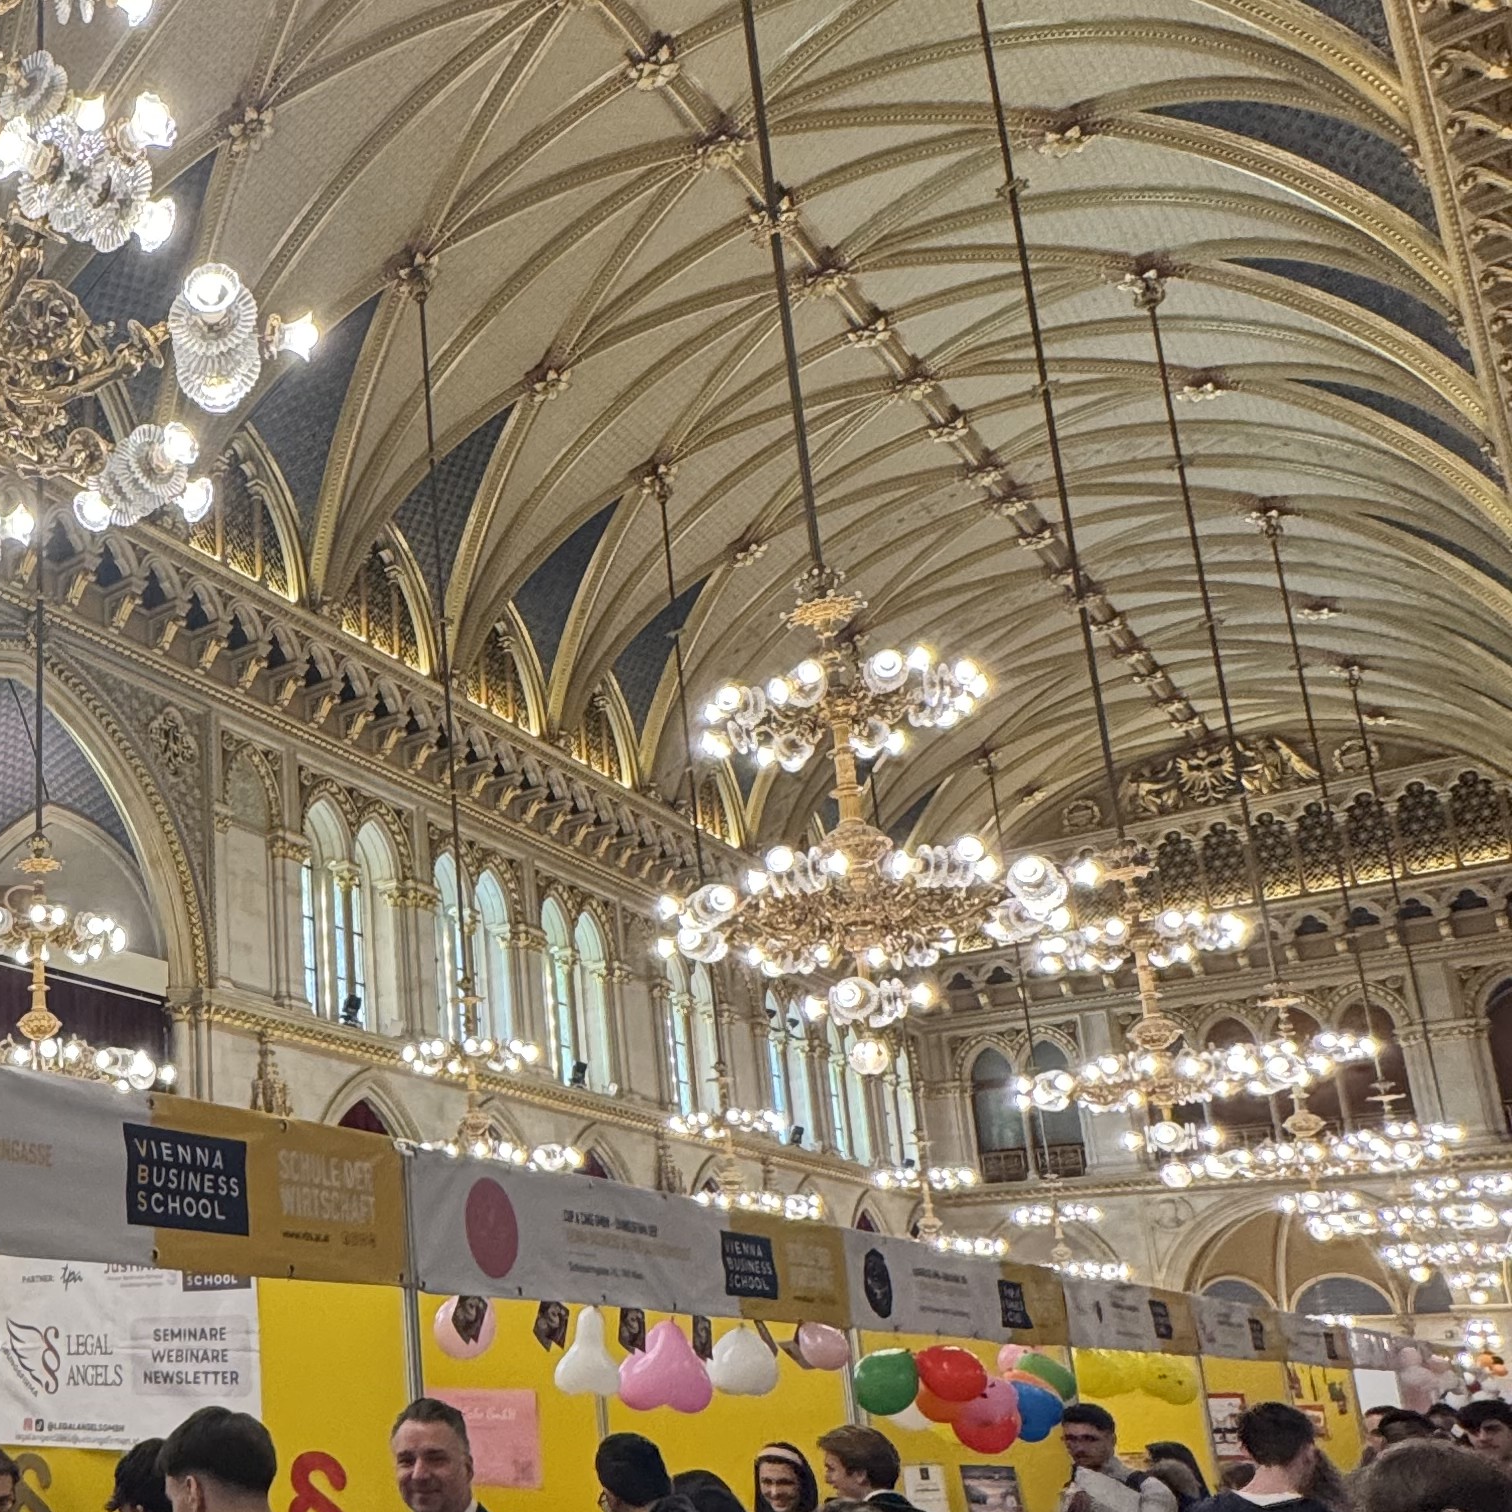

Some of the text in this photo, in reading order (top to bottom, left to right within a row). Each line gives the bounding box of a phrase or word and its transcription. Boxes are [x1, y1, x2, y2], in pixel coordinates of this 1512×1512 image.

[134, 1138, 223, 1169] VIENNA
[138, 1164, 239, 1197] BUSINESS
[137, 1191, 226, 1220] SCHOOL
[66, 1334, 113, 1356] LEGAL
[153, 1327, 226, 1342] SEMINARE
[152, 1349, 228, 1363] WEBINARE
[66, 1364, 123, 1386] ANGELS
[143, 1370, 239, 1385] NEWSLETTER
